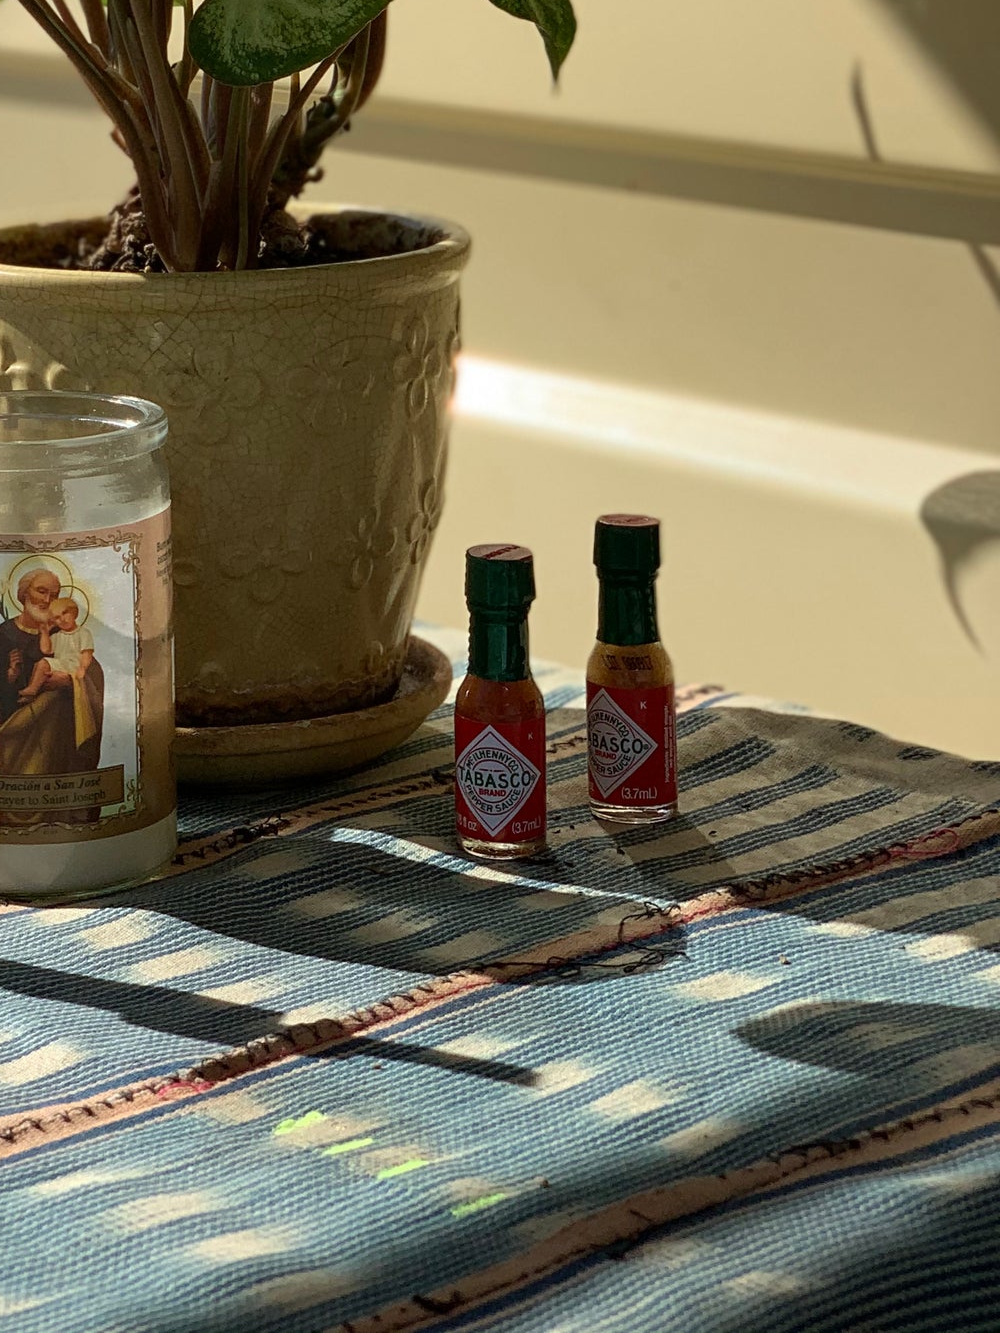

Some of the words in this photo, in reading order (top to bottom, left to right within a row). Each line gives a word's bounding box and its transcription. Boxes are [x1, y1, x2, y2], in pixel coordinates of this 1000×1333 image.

[640, 701, 647, 709] K
[528, 732, 534, 740] K
[595, 749, 616, 760] BRAND
[607, 754, 632, 775] SAUCE
[44, 783, 50, 791] a
[54, 779, 75, 790] San
[77, 775, 102, 789] José
[458, 765, 531, 789] TABASCO
[28, 795, 39, 805] to
[42, 793, 69, 805] Saint
[72, 790, 106, 803] Joseph
[466, 784, 494, 813] PEPPER
[495, 788, 522, 813] SAUCE
[478, 788, 507, 798] BRAND
[621, 785, 658, 800] (3.7mL)
[468, 821, 478, 832] oz
[511, 815, 542, 835] (3.7mL)
